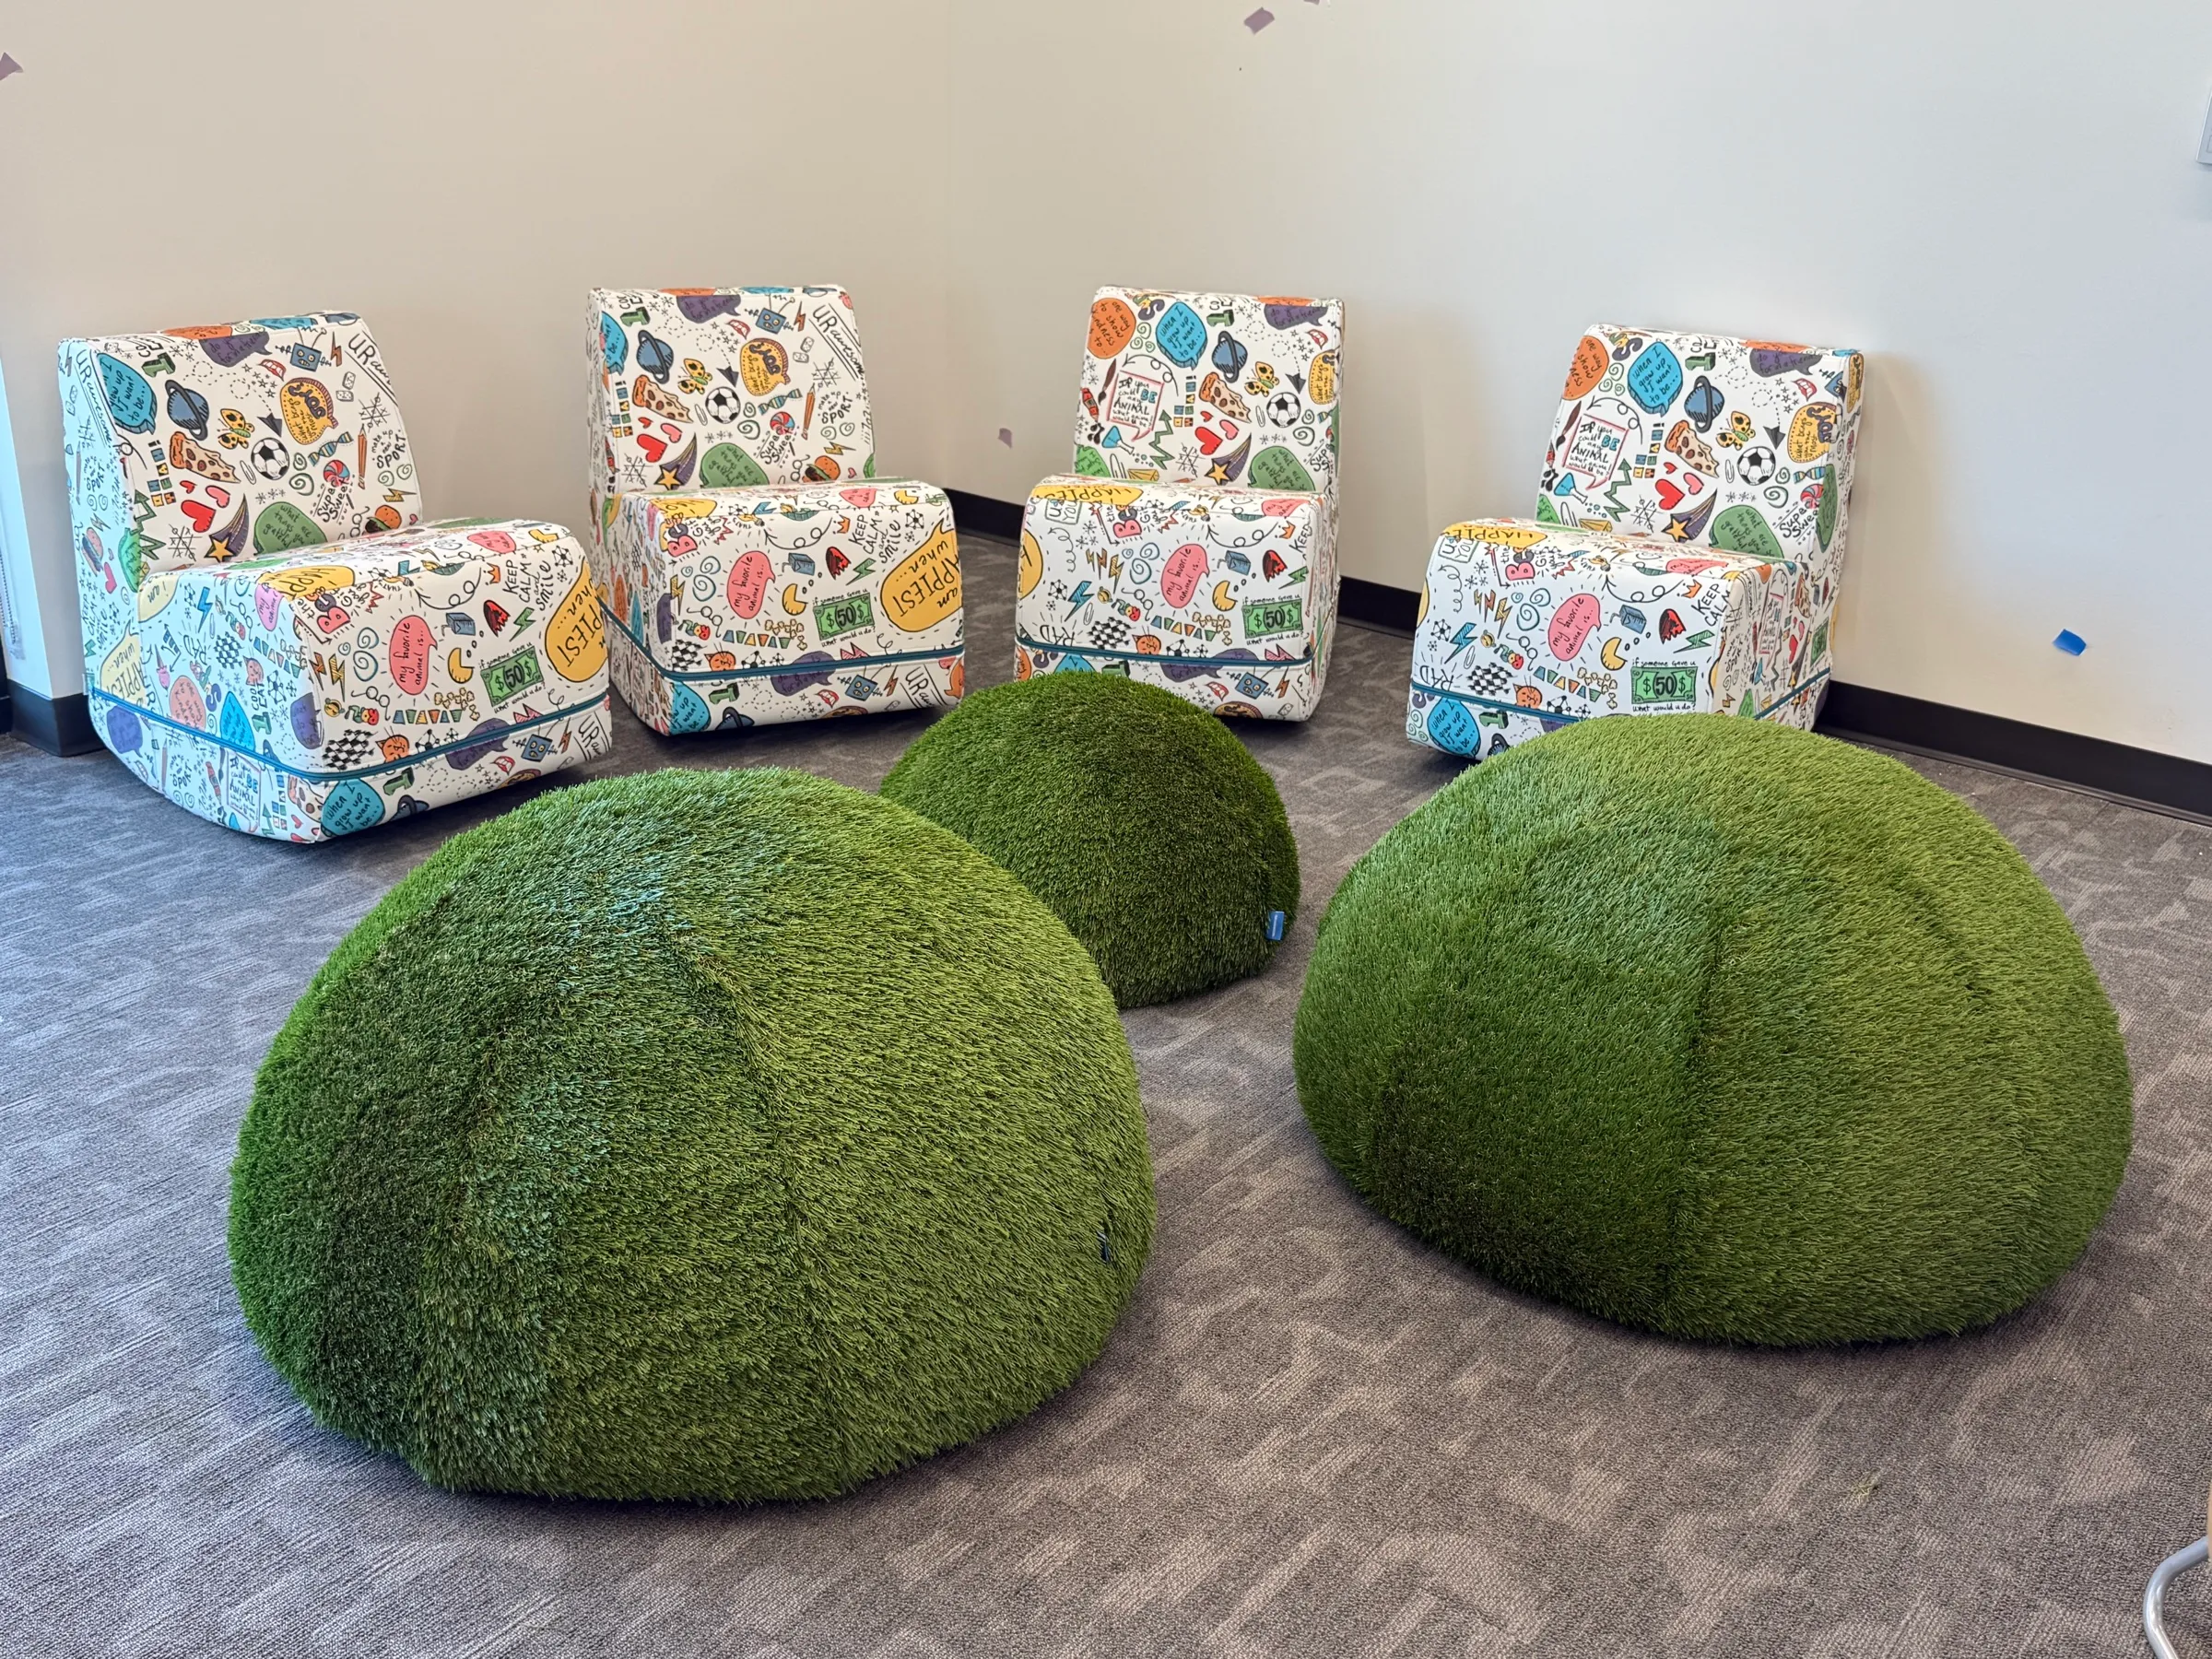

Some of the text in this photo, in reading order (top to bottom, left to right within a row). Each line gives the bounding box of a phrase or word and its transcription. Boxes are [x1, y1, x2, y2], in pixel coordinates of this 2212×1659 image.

[1180, 315, 1189, 328] up
[1182, 322, 1195, 342] want
[1180, 349, 1189, 359] to
[1655, 358, 1666, 371] up
[1656, 364, 1672, 384] want
[1140, 388, 1158, 404] BE
[1650, 394, 1660, 404] to
[820, 395, 853, 424] SPORT
[1580, 420, 1595, 433] If
[376, 433, 406, 468] SPORT
[1601, 434, 1620, 452] BE
[848, 514, 865, 546] KEEP
[1779, 500, 1812, 539] Super
[863, 517, 883, 555] CALM
[878, 528, 888, 550] and
[502, 559, 518, 595] KEEP
[518, 558, 532, 604] CALM
[732, 556, 753, 607] my favorite
[1166, 547, 1192, 597] my favorite
[748, 582, 760, 612] animal
[892, 554, 959, 618] APPIEST
[1179, 573, 1194, 603] animal
[297, 599, 316, 619] the
[1690, 582, 1720, 616] KEEP
[1704, 590, 1731, 627] CALM
[837, 607, 854, 627] 50
[1265, 609, 1283, 628] 50
[1552, 597, 1584, 647] my favorite
[1565, 625, 1583, 654] animal
[393, 622, 416, 683] my favorite
[1639, 659, 1668, 667] someone
[413, 652, 423, 686] animal
[1419, 665, 1454, 692] RAD
[1642, 676, 1687, 696] $ 50 $
[1453, 711, 1461, 724] up
[1653, 701, 1674, 711] would
[1453, 718, 1467, 737] want
[354, 792, 364, 807] up
[355, 796, 371, 820] want
